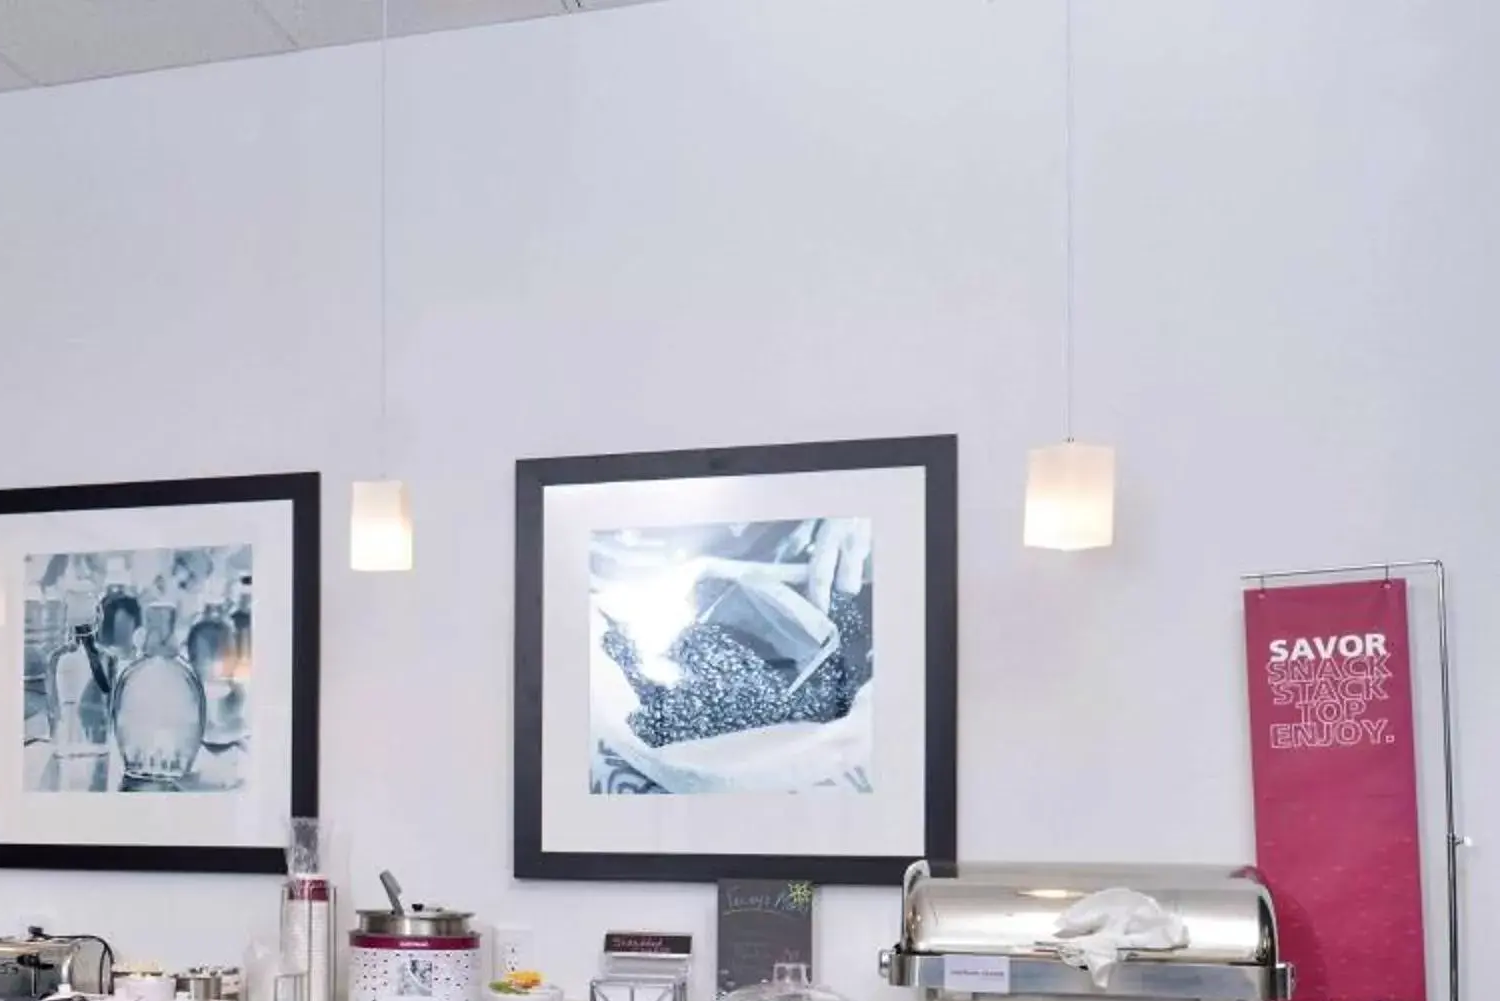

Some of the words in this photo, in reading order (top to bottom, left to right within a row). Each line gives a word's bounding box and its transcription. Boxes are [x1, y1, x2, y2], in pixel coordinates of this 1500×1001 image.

[1268, 632, 1387, 662] SAVOR
[1266, 653, 1393, 684] SNACK
[1271, 677, 1389, 706] STACK
[1295, 698, 1366, 725] TOP
[1269, 719, 1395, 749] ENJOY.
